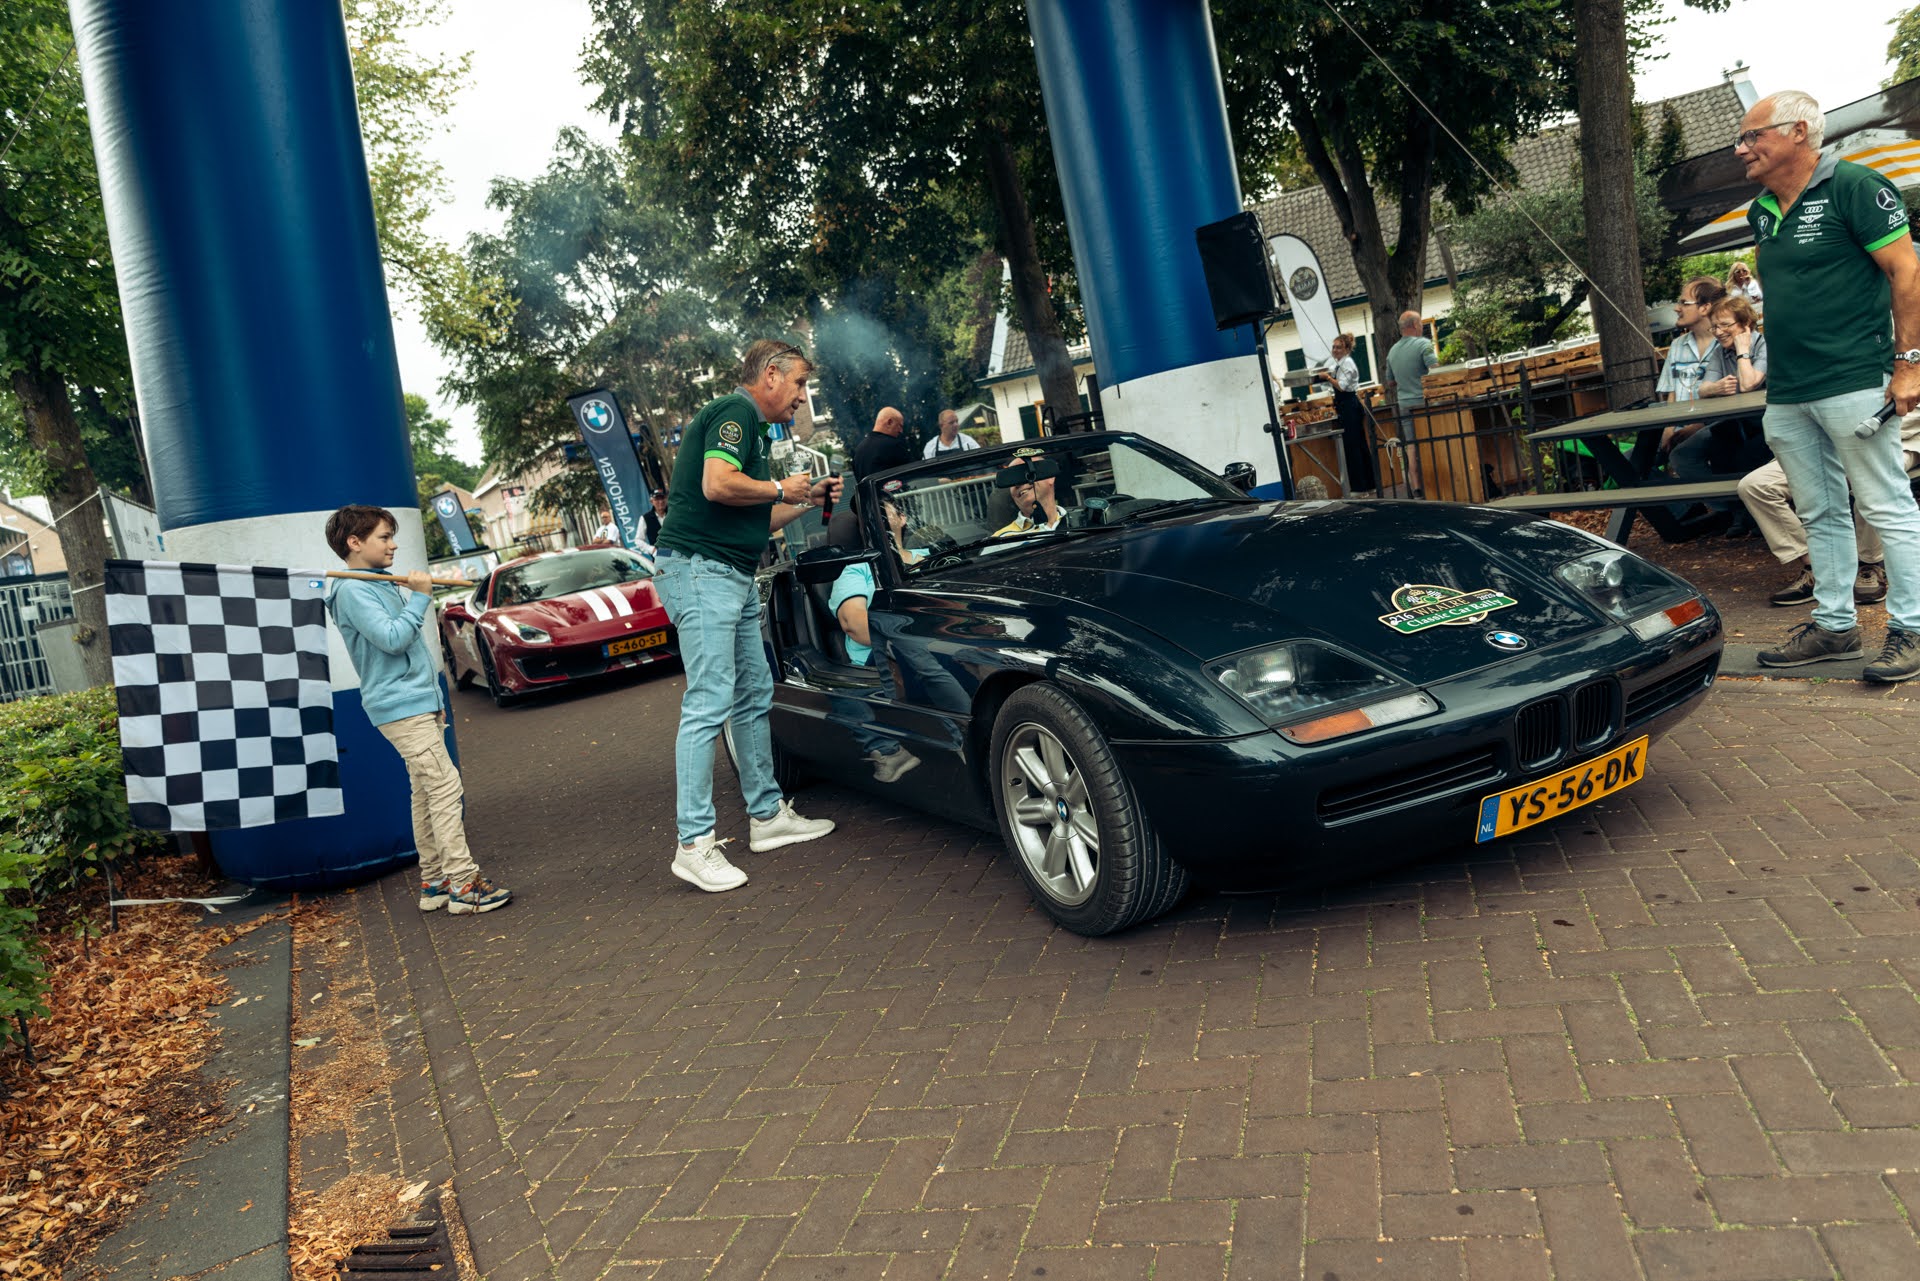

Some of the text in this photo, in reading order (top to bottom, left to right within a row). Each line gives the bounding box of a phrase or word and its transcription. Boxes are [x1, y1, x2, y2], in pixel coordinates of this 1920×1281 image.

[1389, 611, 1415, 624] 216
[1414, 598, 1471, 616] WAALRE
[1407, 612, 1451, 627] Classic
[1449, 605, 1470, 616] Car
[1471, 598, 1504, 611] Rally
[613, 633, 662, 654] S-460-ST
[1511, 747, 1640, 826] YS-56-DK
[1481, 822, 1494, 834] NL
